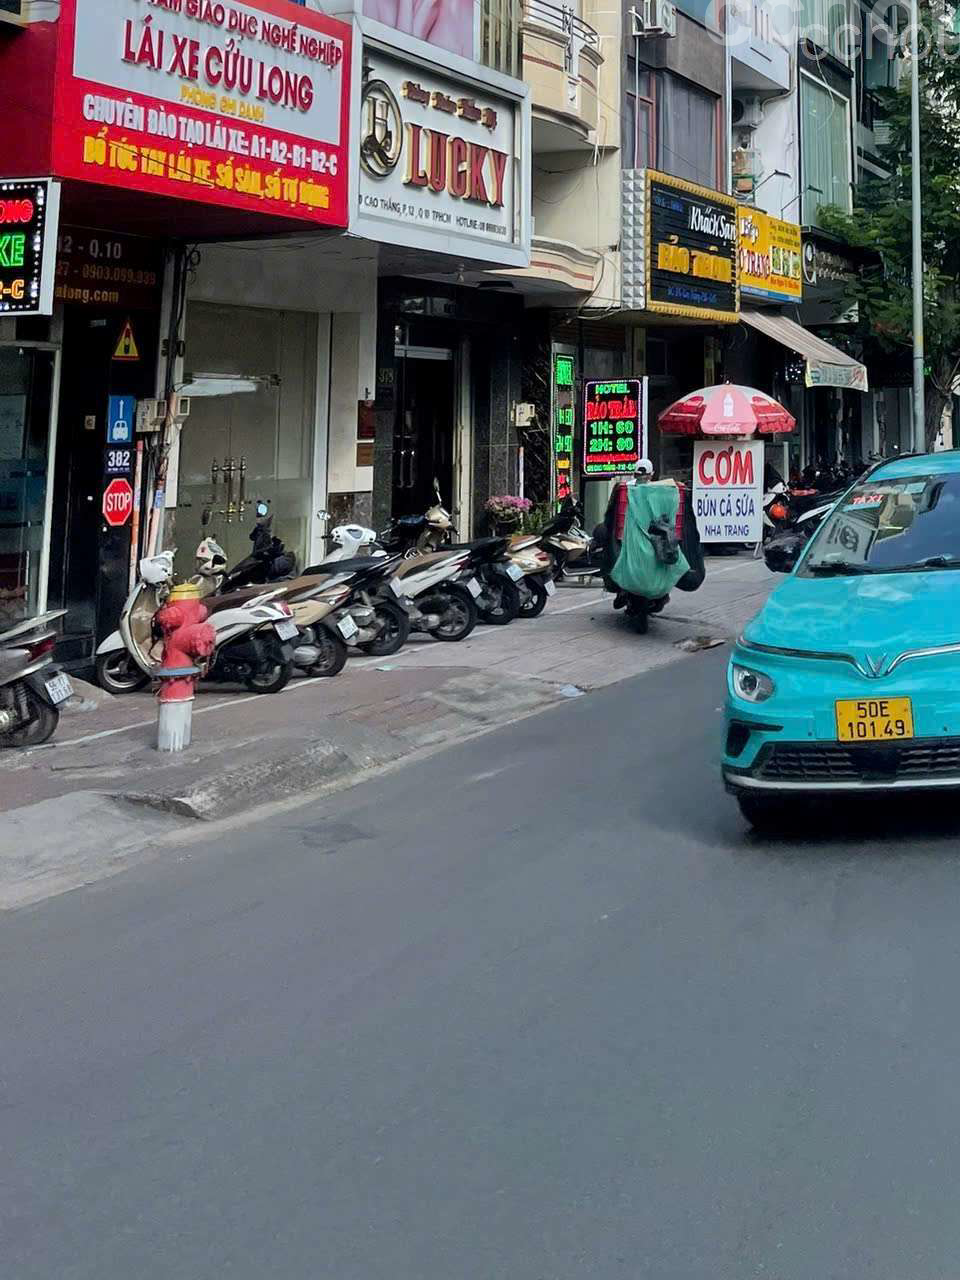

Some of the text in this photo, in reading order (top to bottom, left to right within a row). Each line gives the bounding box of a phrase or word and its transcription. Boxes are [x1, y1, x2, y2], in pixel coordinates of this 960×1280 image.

[227, 8, 258, 42] DỤC
[122, 14, 314, 113] LÁI XE CỬU LONG
[83, 93, 145, 132] CHUYÊN
[147, 105, 177, 139] ĐÀO
[178, 116, 205, 148] TẠO
[205, 120, 227, 150] LÁI
[83, 125, 108, 166] BỔ
[109, 136, 138, 172] TÚC
[167, 149, 192, 182] LÁI
[215, 156, 234, 190] SỐ
[264, 167, 281, 200] SỐ
[402, 122, 510, 208] LUCKY
[89, 239, 122, 259] Q.10
[595, 384, 630, 395] HOTEL
[108, 451, 130, 467] 382
[697, 446, 754, 486] CƠM
[107, 492, 131, 512] STOP
[697, 493, 755, 516] BÚN CÁ SỨA
[851, 494, 885, 505] TAXI
[704, 524, 750, 536] NHA TRANG
[857, 701, 890, 719] 50E
